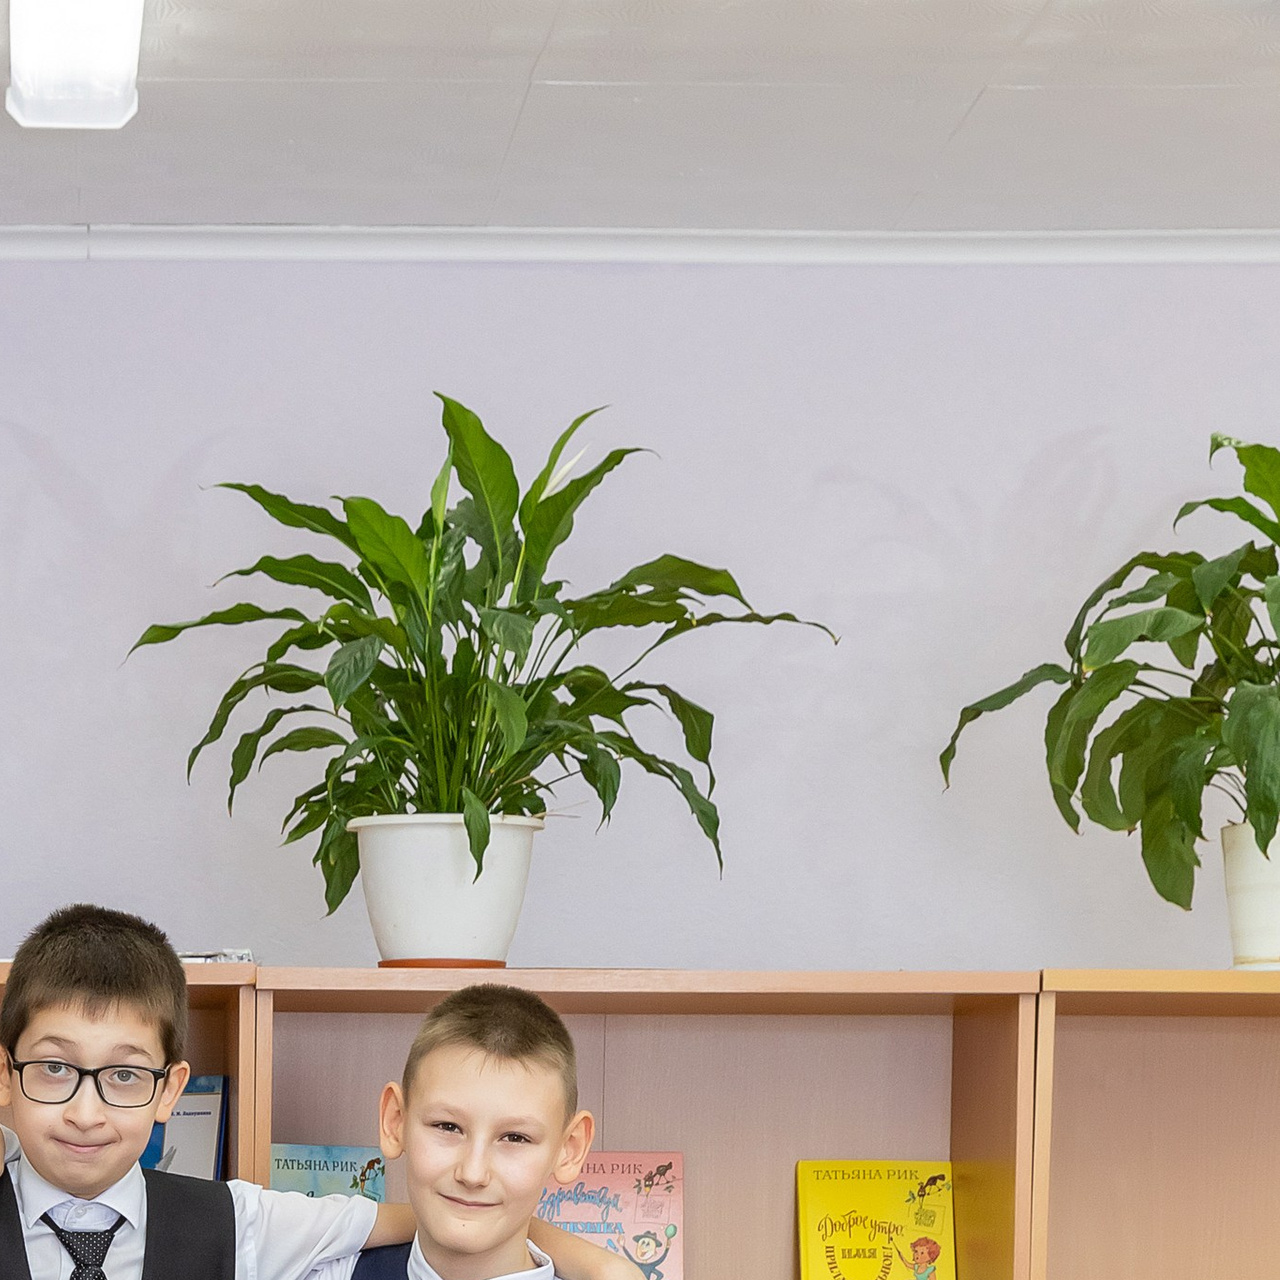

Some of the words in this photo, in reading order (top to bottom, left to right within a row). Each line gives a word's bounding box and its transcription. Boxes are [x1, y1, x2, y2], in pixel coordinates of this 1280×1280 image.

[275, 1158, 329, 1171] ТАТЬЯНА
[333, 1161, 358, 1172] РИК
[611, 1164, 643, 1174] РИК
[813, 1169, 883, 1180] ТАТЬЯНА
[887, 1170, 920, 1180] РИК
[818, 1209, 869, 1242] Доброе
